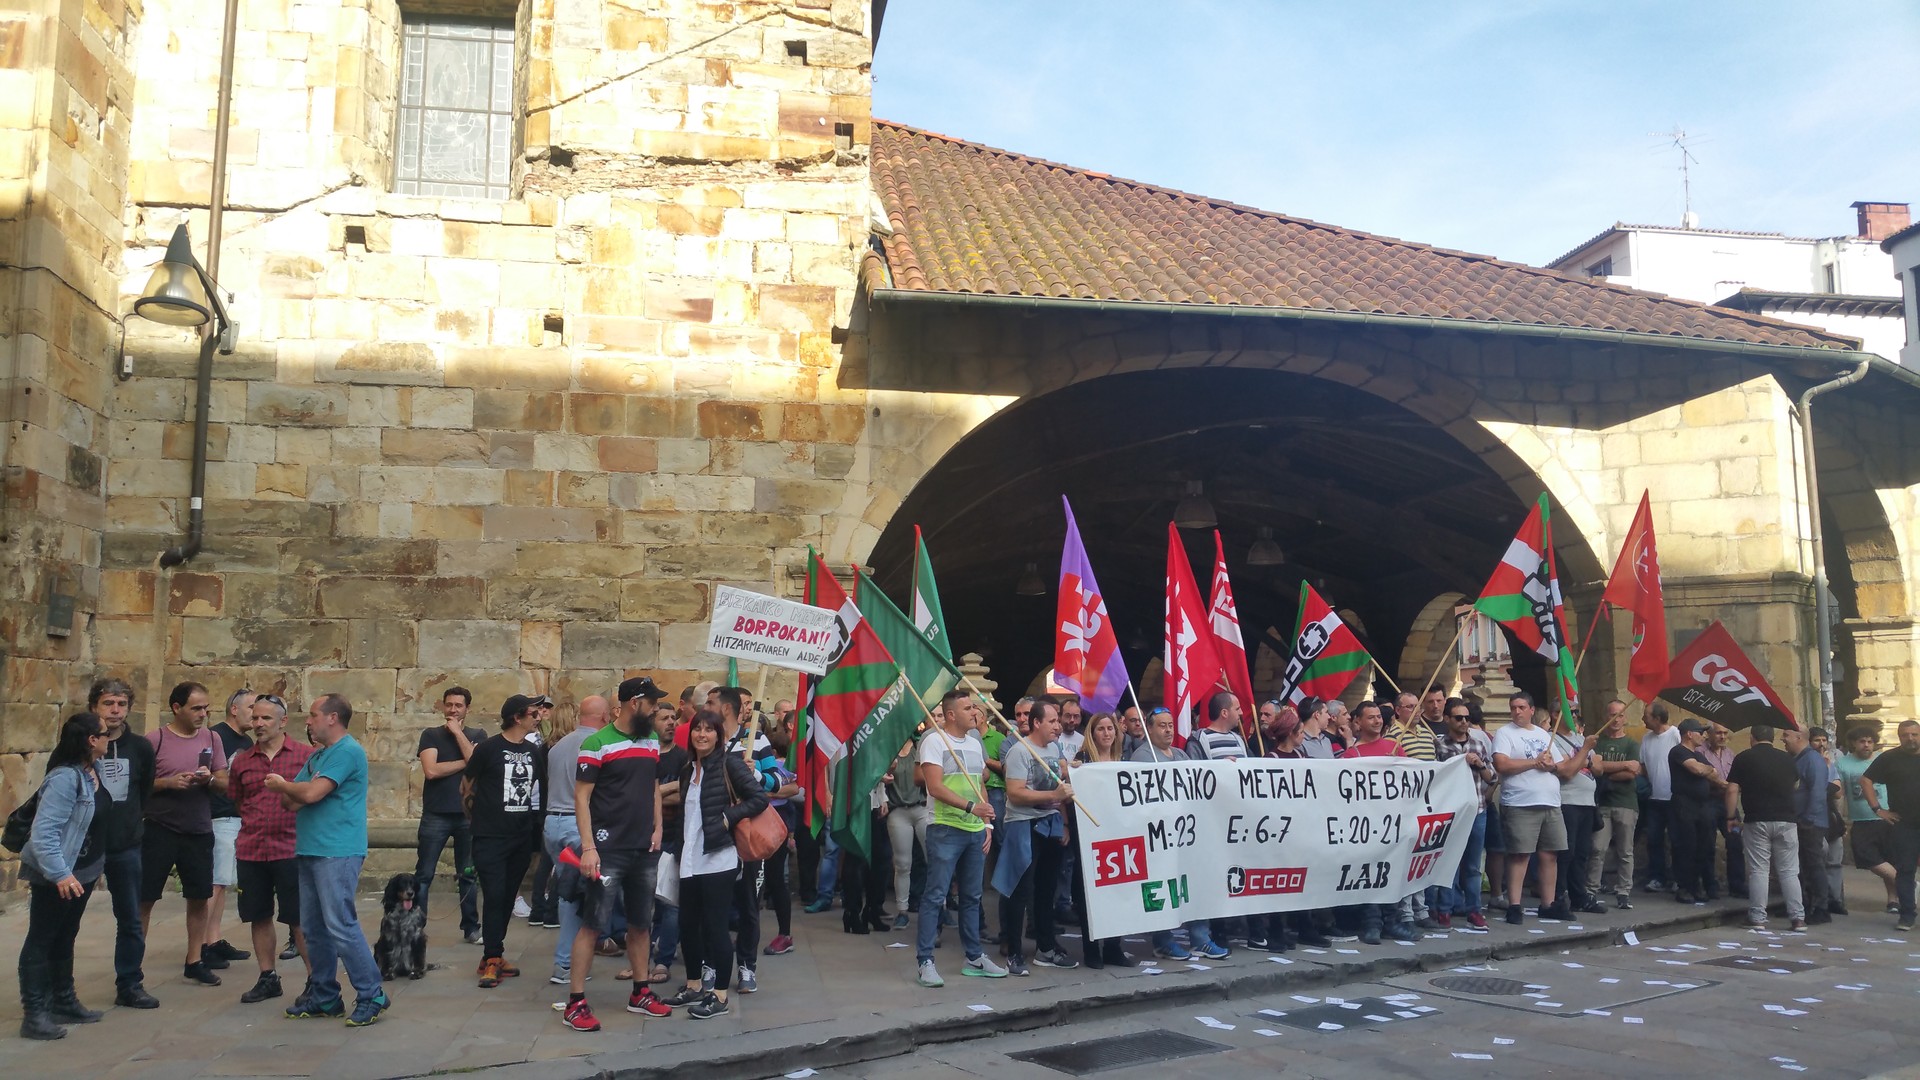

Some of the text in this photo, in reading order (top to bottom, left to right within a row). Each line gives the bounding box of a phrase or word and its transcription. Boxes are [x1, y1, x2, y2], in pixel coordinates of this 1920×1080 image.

[733, 616, 830, 651] BORROKAN!!
[713, 635, 828, 668] HITZARMENAREN ALDE!!
[1692, 654, 1771, 707] CGT
[1682, 688, 1724, 713] CGT-LKN
[1238, 769, 1317, 799] METALA
[1338, 769, 1435, 813] GREBAN!
[1420, 820, 1452, 847] CGT
[1250, 873, 1302, 890] CCOO
[1336, 861, 1391, 892] LAB
[1407, 851, 1446, 882] UGT
